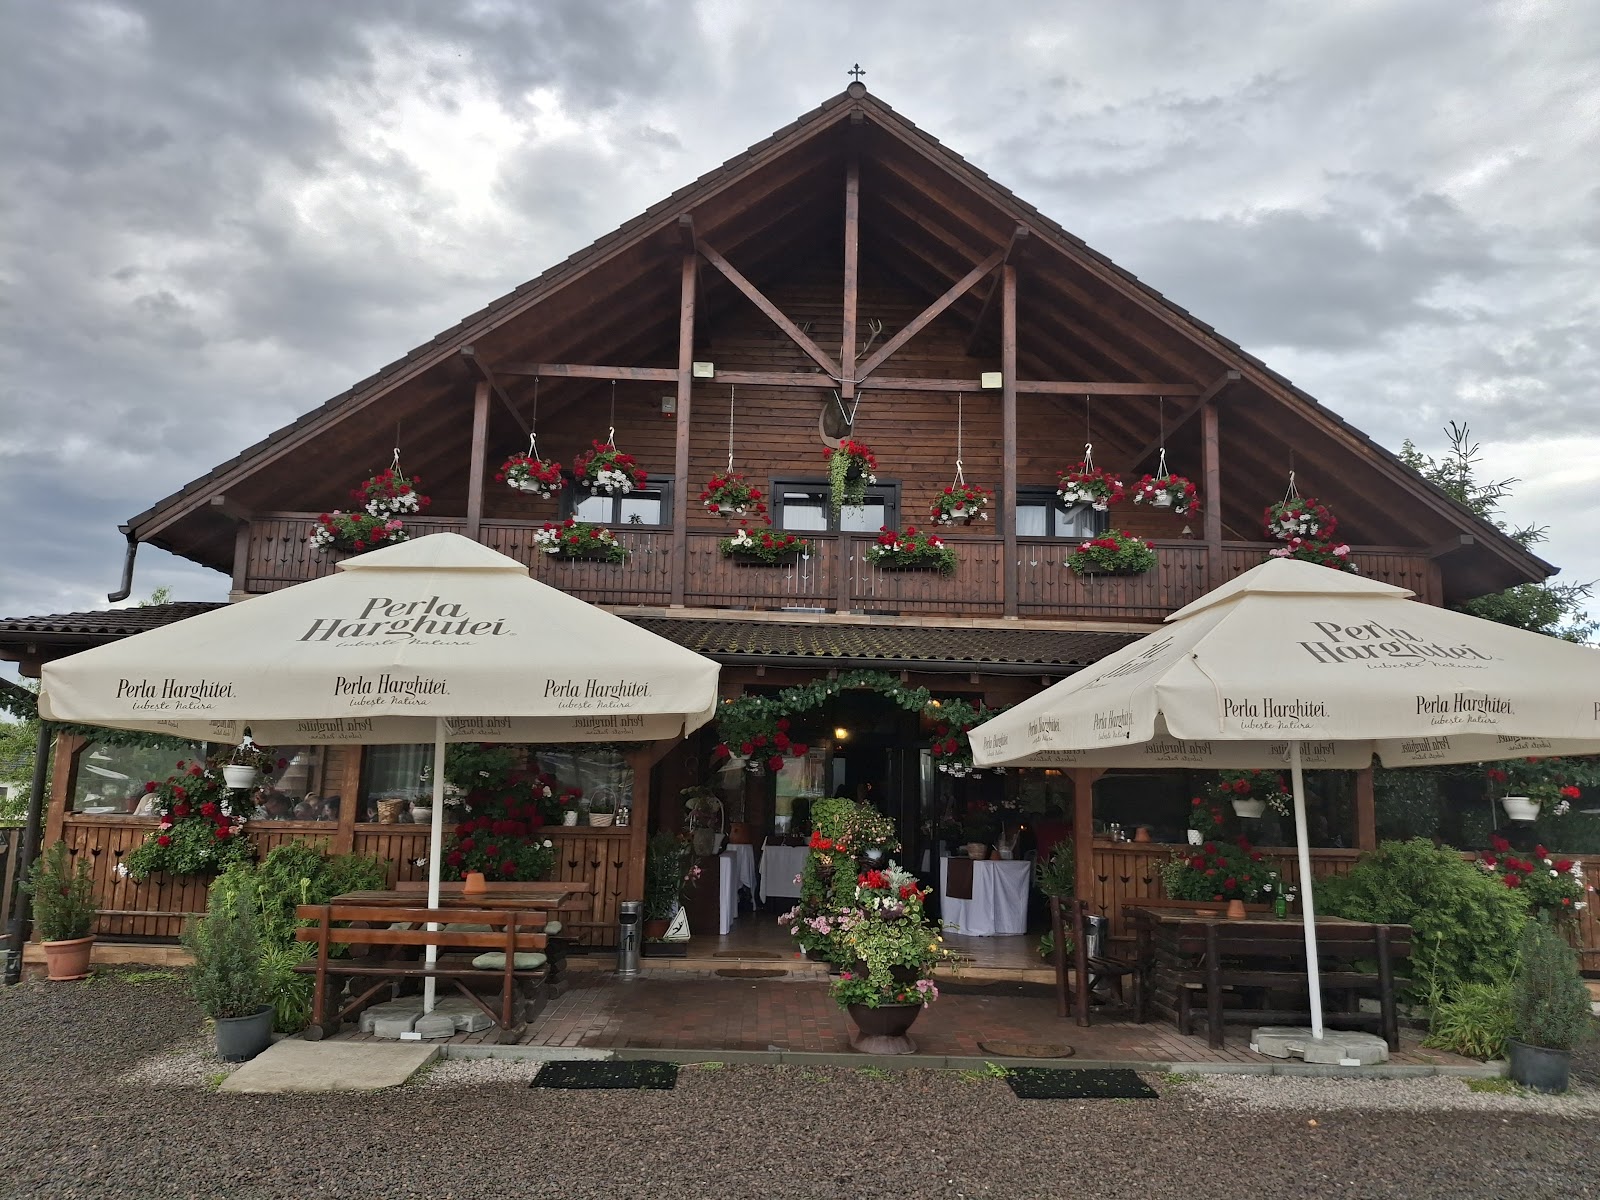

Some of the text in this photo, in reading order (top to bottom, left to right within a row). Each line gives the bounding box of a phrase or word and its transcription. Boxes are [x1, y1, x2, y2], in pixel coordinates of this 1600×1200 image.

[357, 595, 468, 620] Perla
[296, 614, 512, 642] Harghitei
[1310, 618, 1424, 643] Perla
[1296, 637, 1493, 664] Harghitei
[116, 678, 234, 704] Perla Harghitei
[334, 673, 447, 699] Perla Harghitei
[543, 678, 651, 703] Perla Harghitei
[1224, 697, 1328, 722] Perla Harghitei
[1416, 692, 1513, 717] Perla Harghitei
